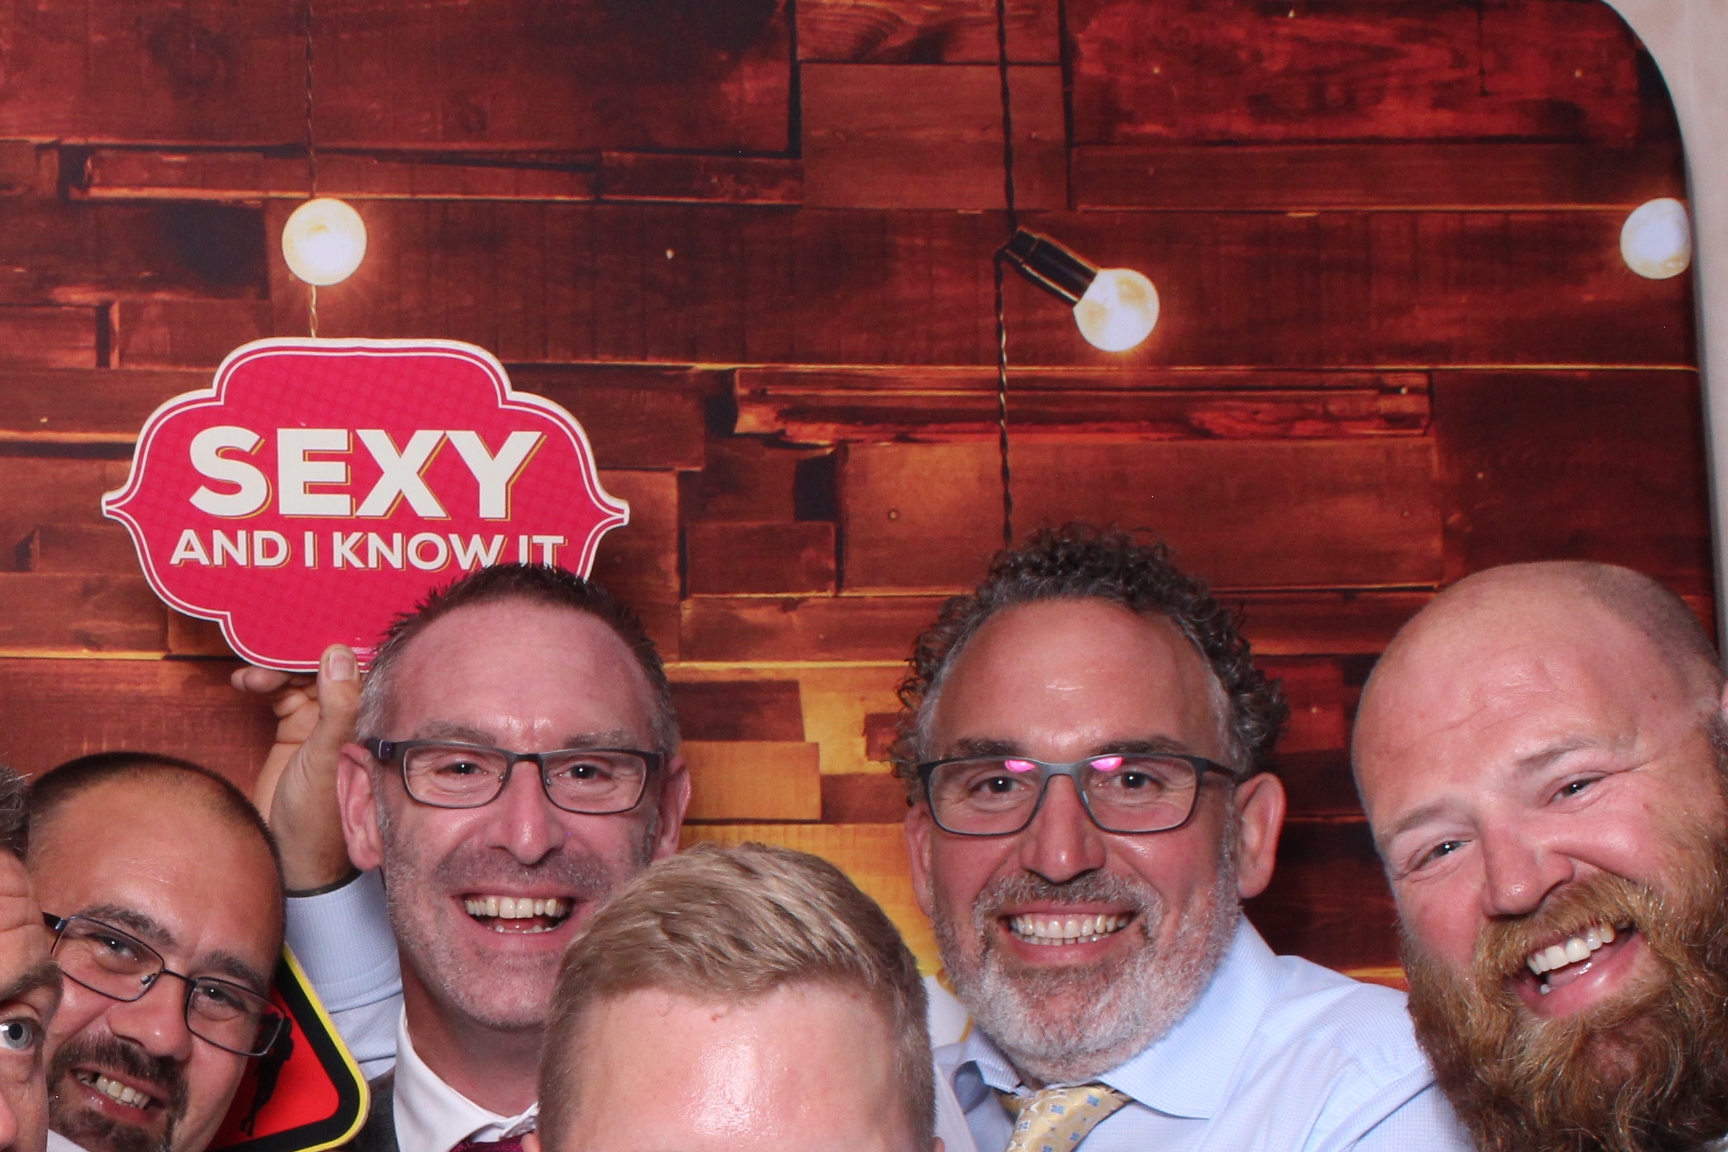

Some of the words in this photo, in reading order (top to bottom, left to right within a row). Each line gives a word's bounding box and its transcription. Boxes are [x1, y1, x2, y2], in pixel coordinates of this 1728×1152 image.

[188, 424, 547, 520] SEXY
[170, 528, 290, 569] AND
[304, 530, 319, 570] I
[332, 531, 506, 571] KNOW
[518, 534, 567, 569] IT
